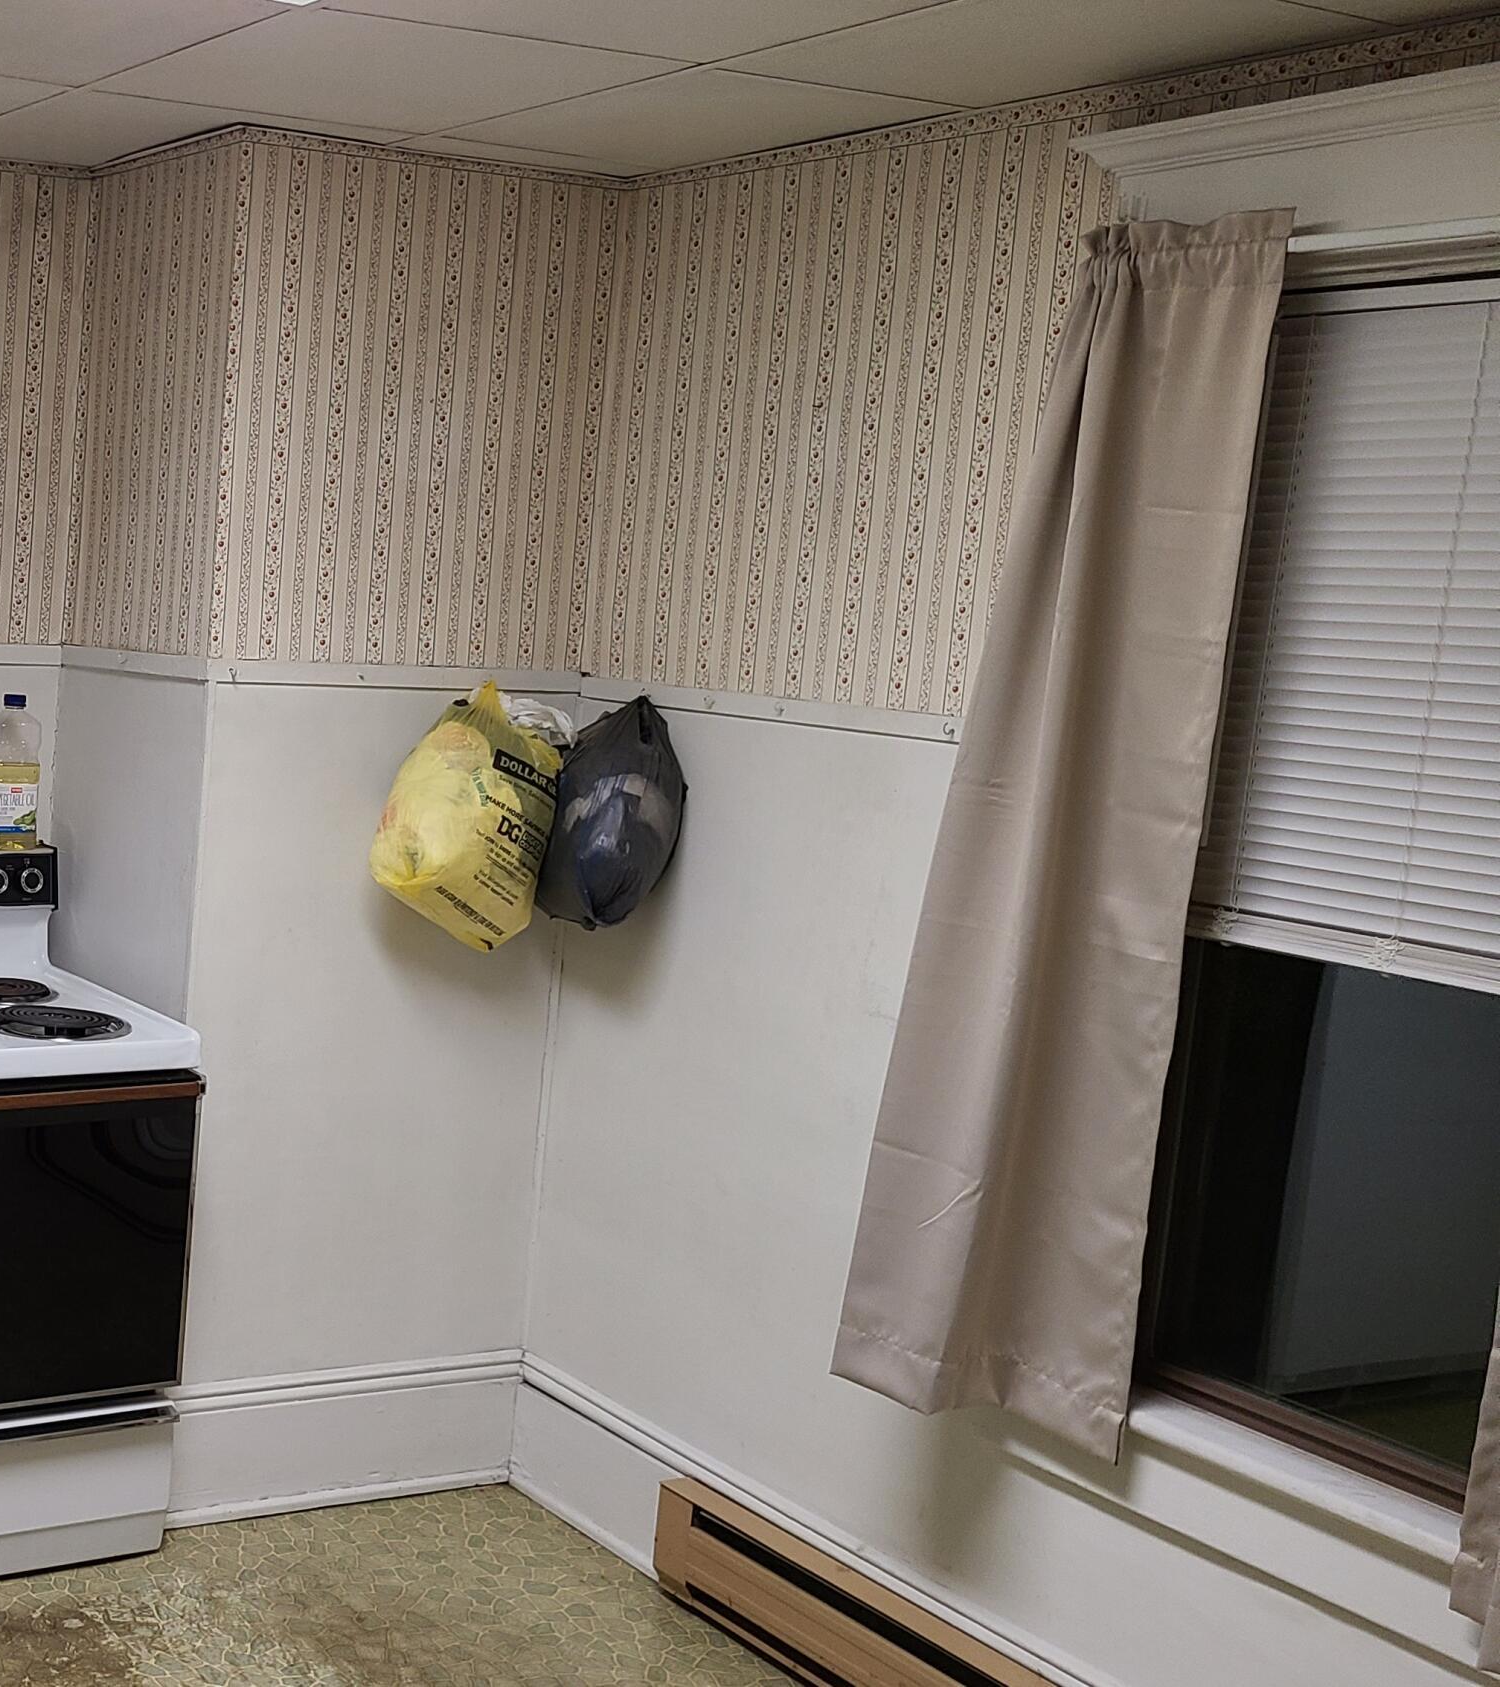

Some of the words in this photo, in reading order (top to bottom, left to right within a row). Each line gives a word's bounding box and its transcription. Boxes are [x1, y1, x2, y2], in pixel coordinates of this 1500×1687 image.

[499, 755, 548, 789] DOLLAR
[485, 794, 507, 811] MAKE
[505, 805, 526, 822] MORE
[496, 814, 523, 845] DG
